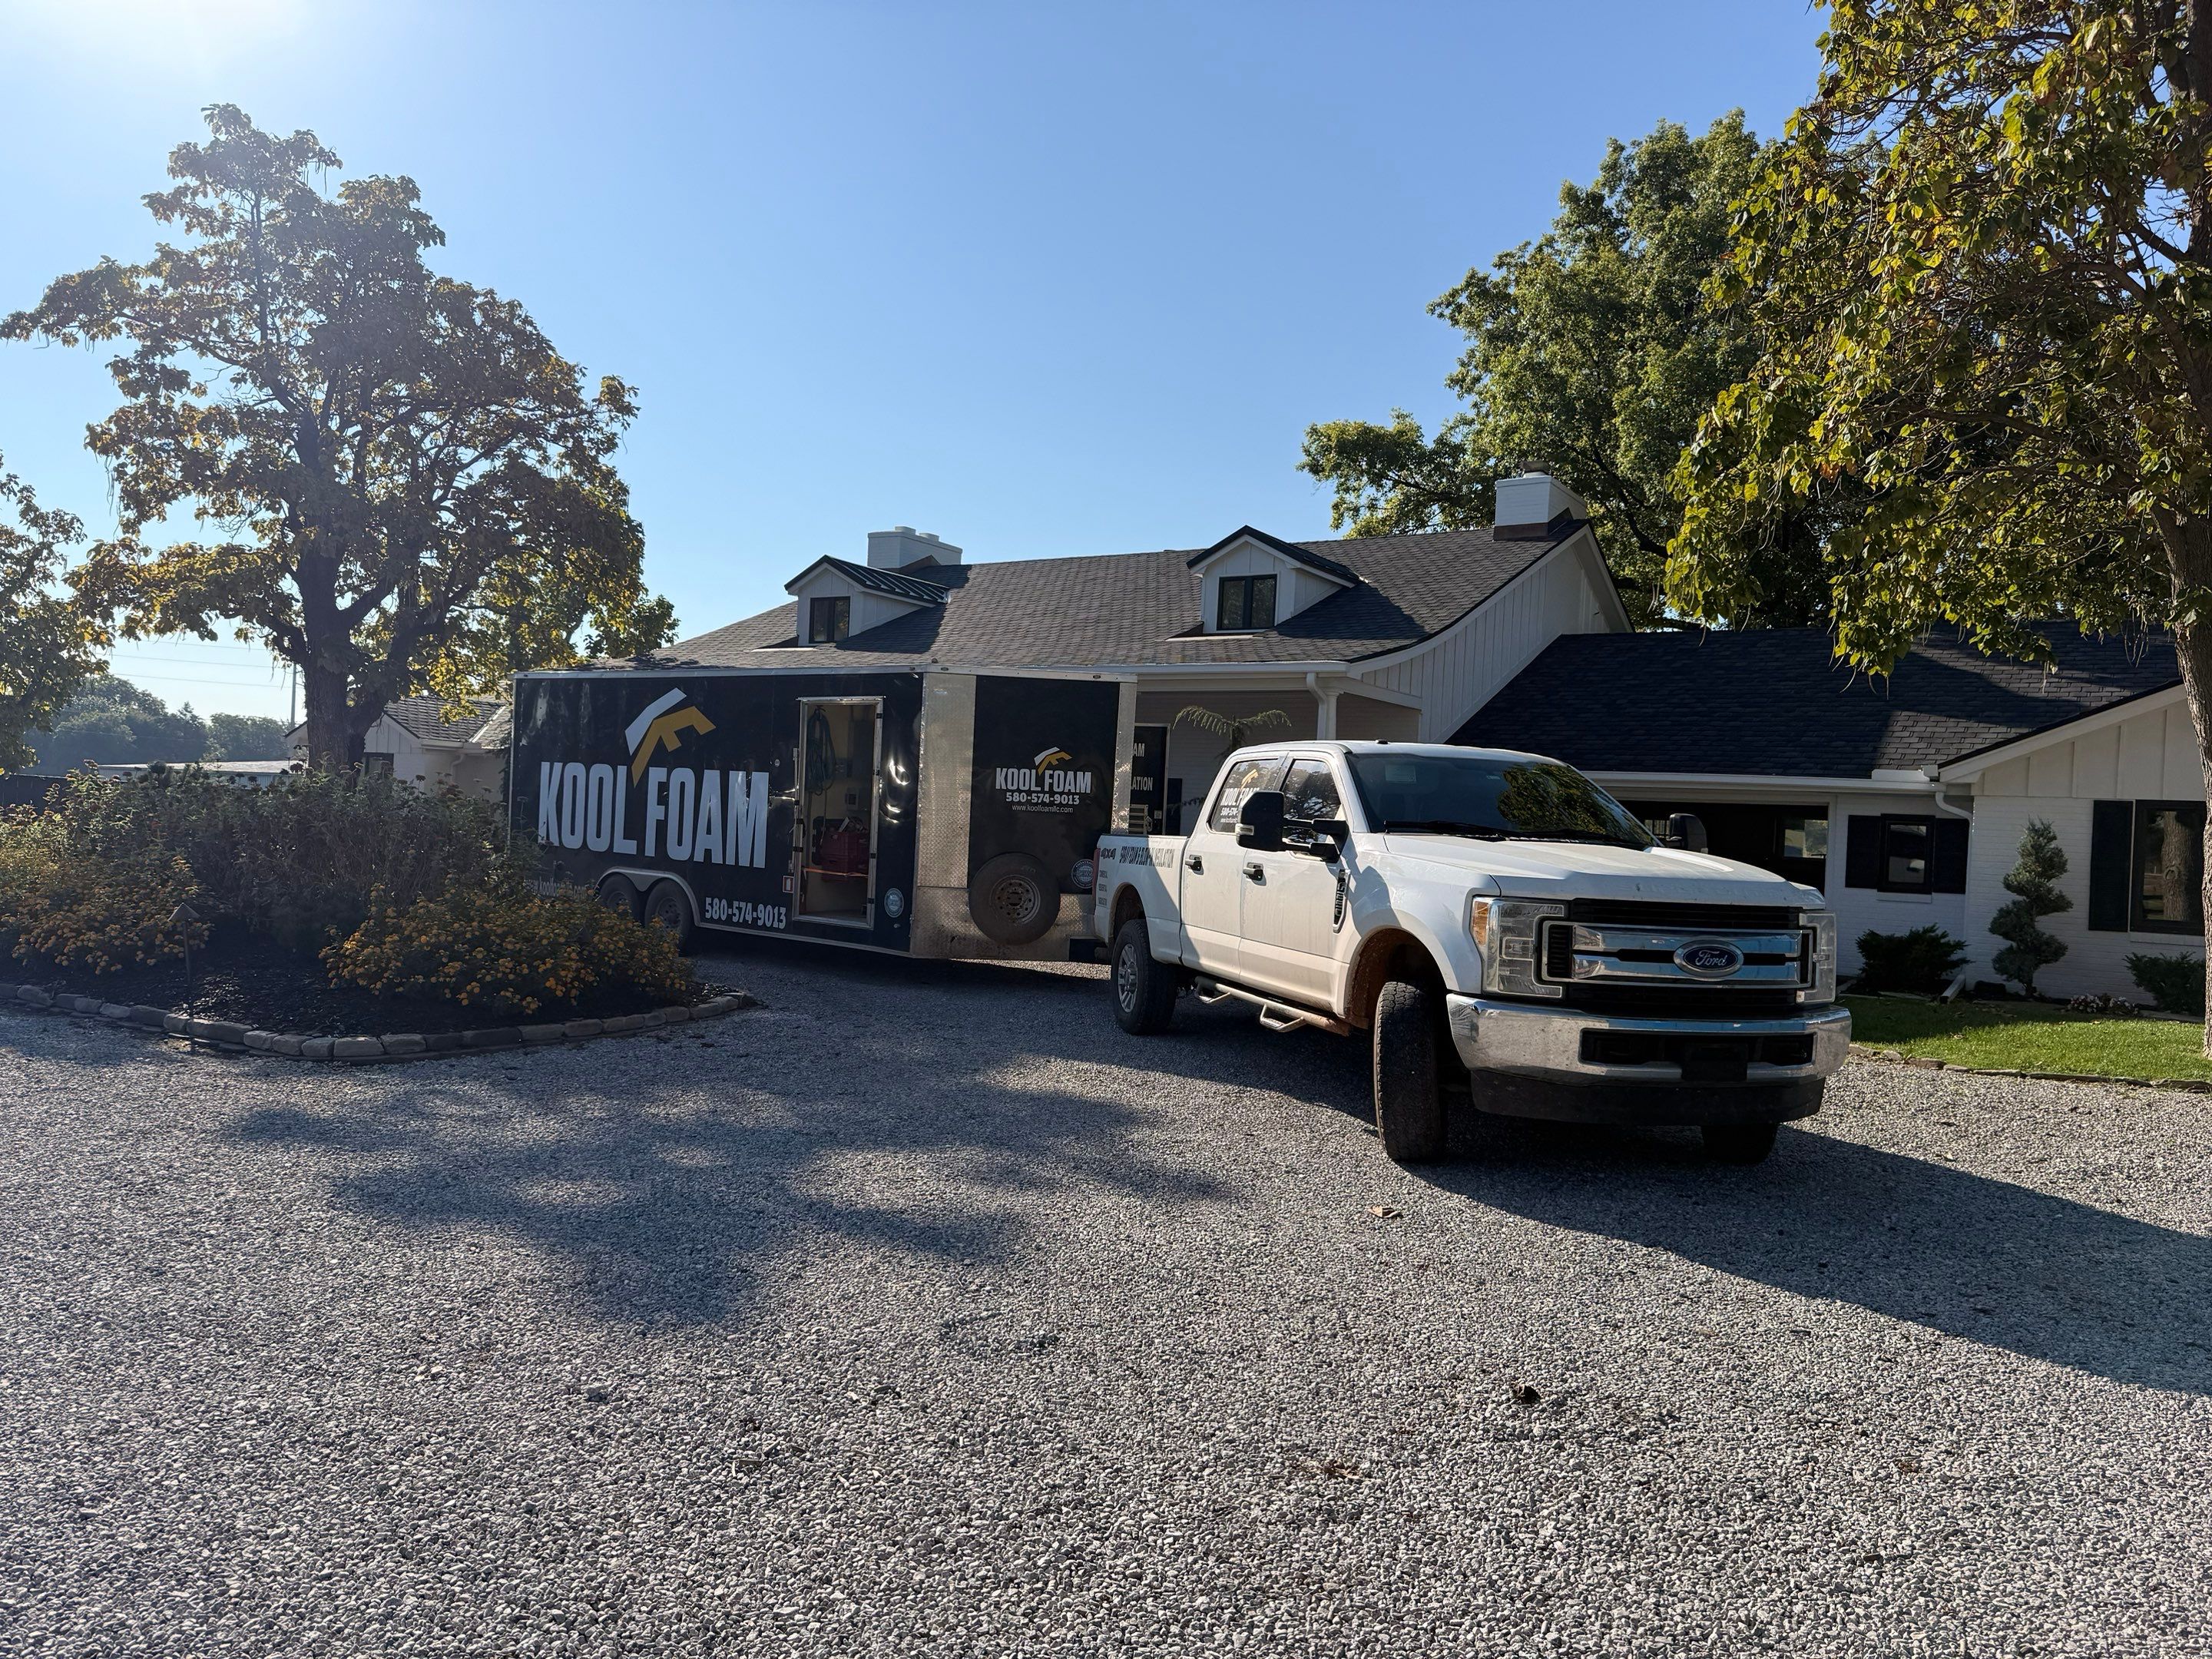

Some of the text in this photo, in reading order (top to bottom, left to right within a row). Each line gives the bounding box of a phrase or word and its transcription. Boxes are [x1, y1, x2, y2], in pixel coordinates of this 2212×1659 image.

[1133, 743, 1145, 757] AM
[995, 767, 1091, 793] KOOL FOAM
[1130, 776, 1154, 791] ATION
[1005, 792, 1080, 805] 580-574-9013
[538, 761, 770, 869] KOOL FOAM
[1012, 804, 1074, 813] www.koolfoamllc.com
[705, 897, 786, 929] 580-574-9013
[1694, 949, 1728, 966] Ford
